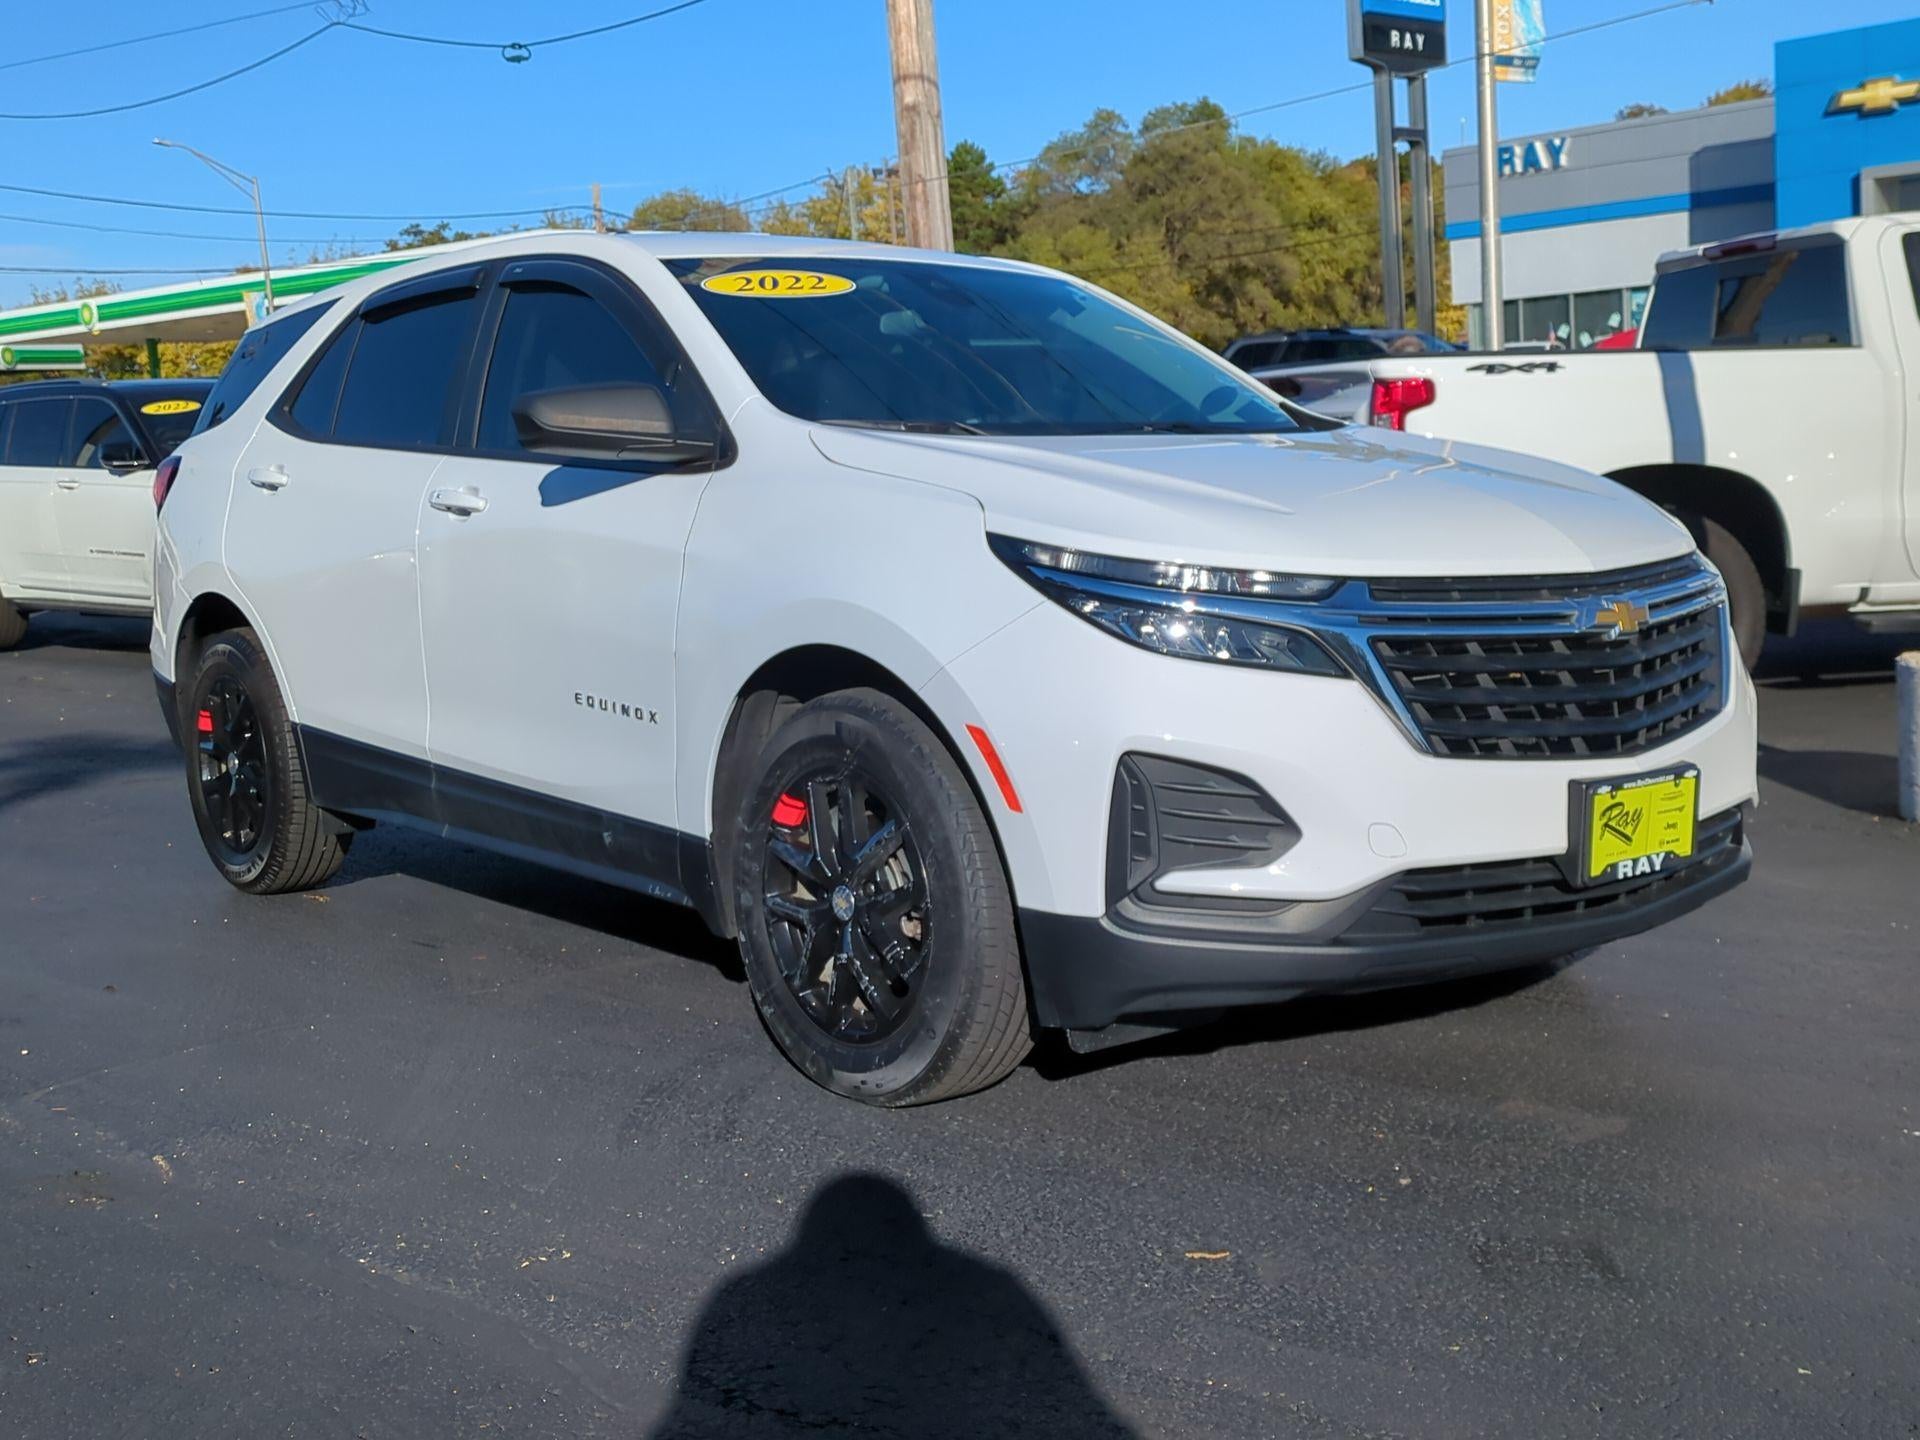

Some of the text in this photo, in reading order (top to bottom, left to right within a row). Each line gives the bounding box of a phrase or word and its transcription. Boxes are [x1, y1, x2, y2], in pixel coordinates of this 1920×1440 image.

[1390, 29, 1425, 52] RAY
[1497, 137, 1569, 177] RAY
[734, 275, 828, 292] 2022
[574, 692, 658, 724] EQUINOX
[1599, 802, 1644, 847] Ray
[1617, 852, 1666, 880] RAY
